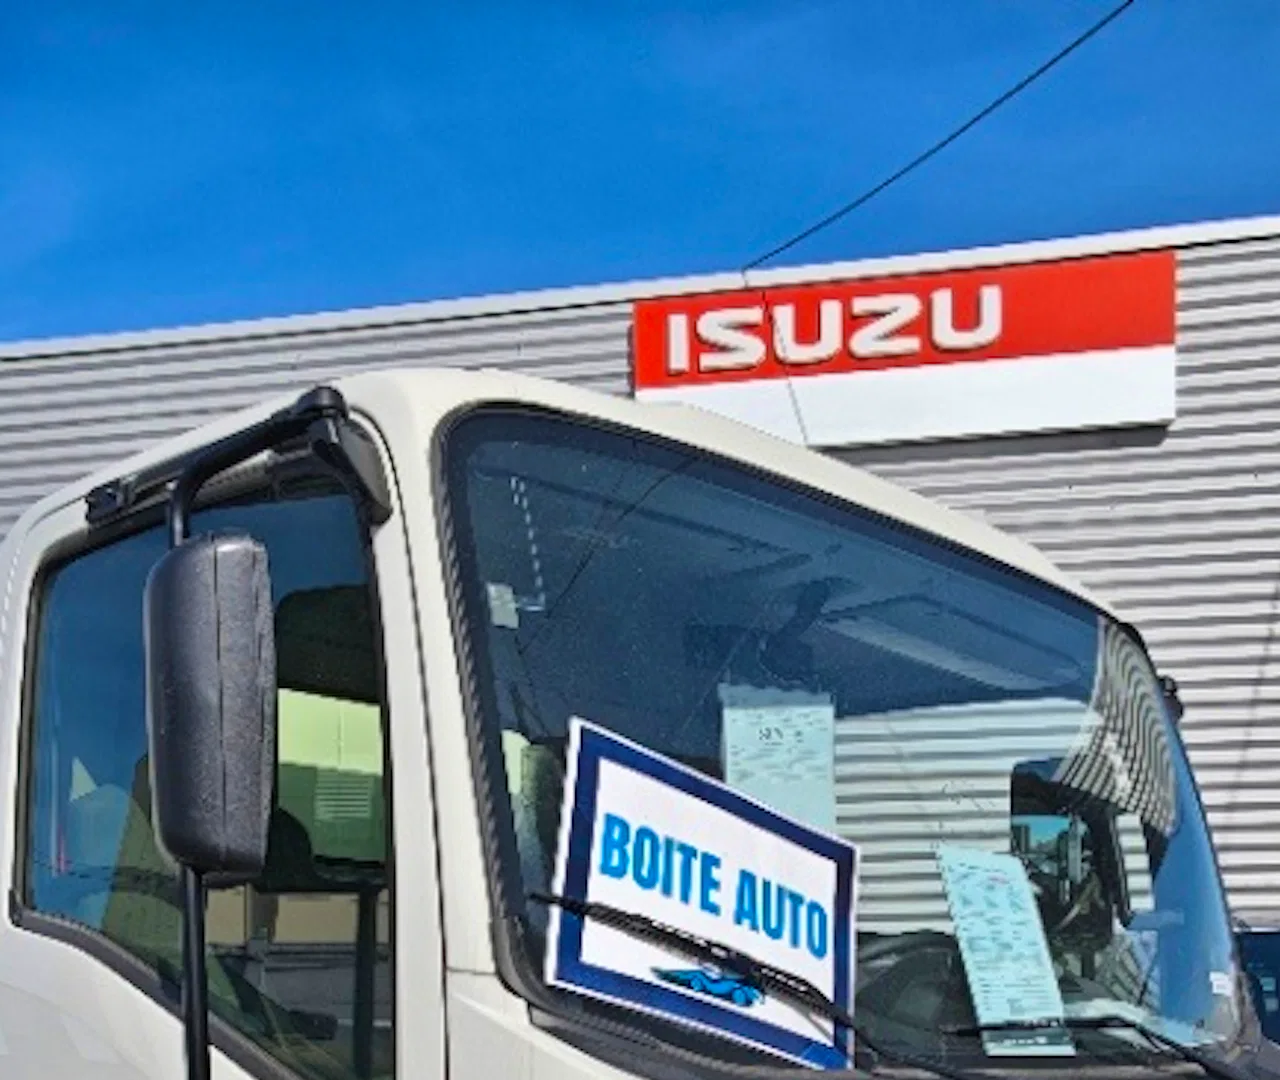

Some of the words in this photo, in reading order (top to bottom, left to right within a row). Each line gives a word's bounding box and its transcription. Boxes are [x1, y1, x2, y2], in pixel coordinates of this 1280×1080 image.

[666, 284, 1003, 374] ISUZU
[598, 812, 722, 917] BOITE
[733, 868, 828, 960] AUTO
